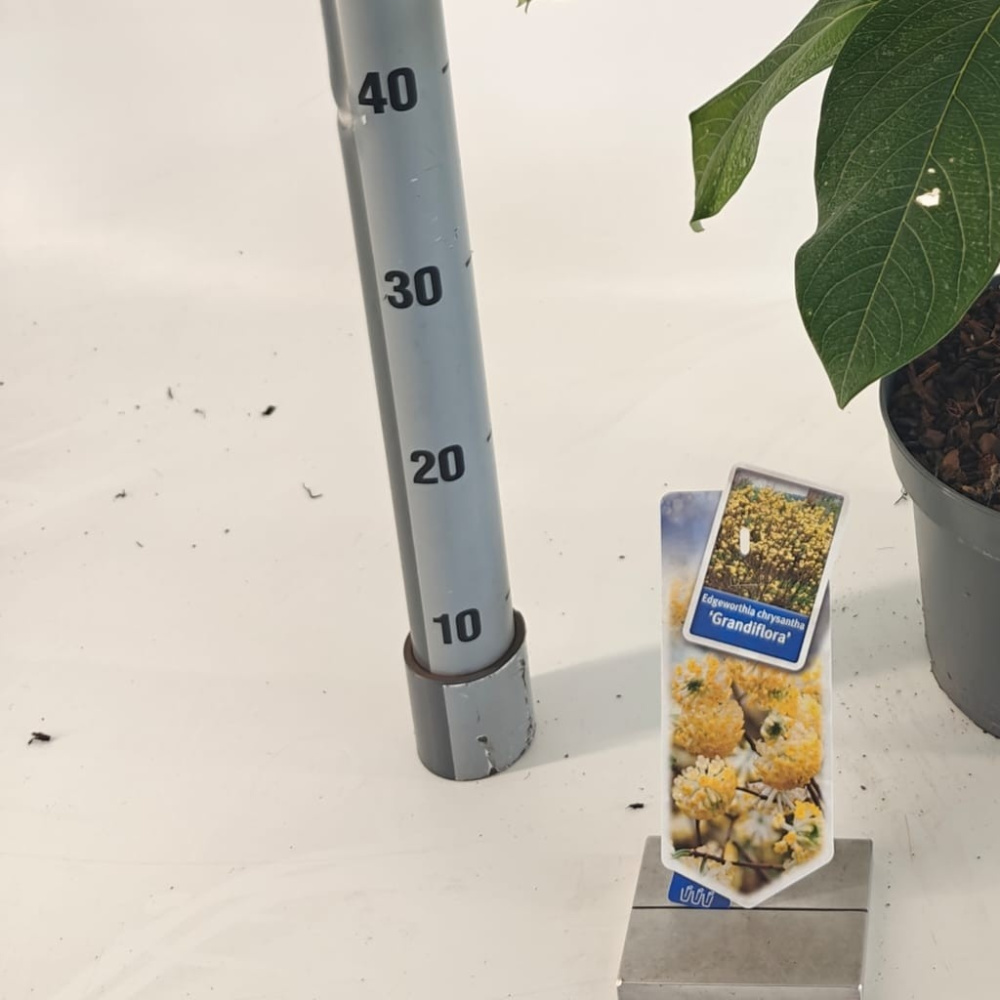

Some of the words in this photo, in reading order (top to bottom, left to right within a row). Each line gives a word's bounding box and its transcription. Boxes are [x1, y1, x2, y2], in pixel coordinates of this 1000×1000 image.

[357, 67, 418, 115] 40
[384, 265, 442, 310] 30
[410, 444, 466, 485] 20
[433, 608, 482, 645] 10
[702, 593, 755, 616] Edgeworthia
[756, 608, 805, 630] chrysantha
